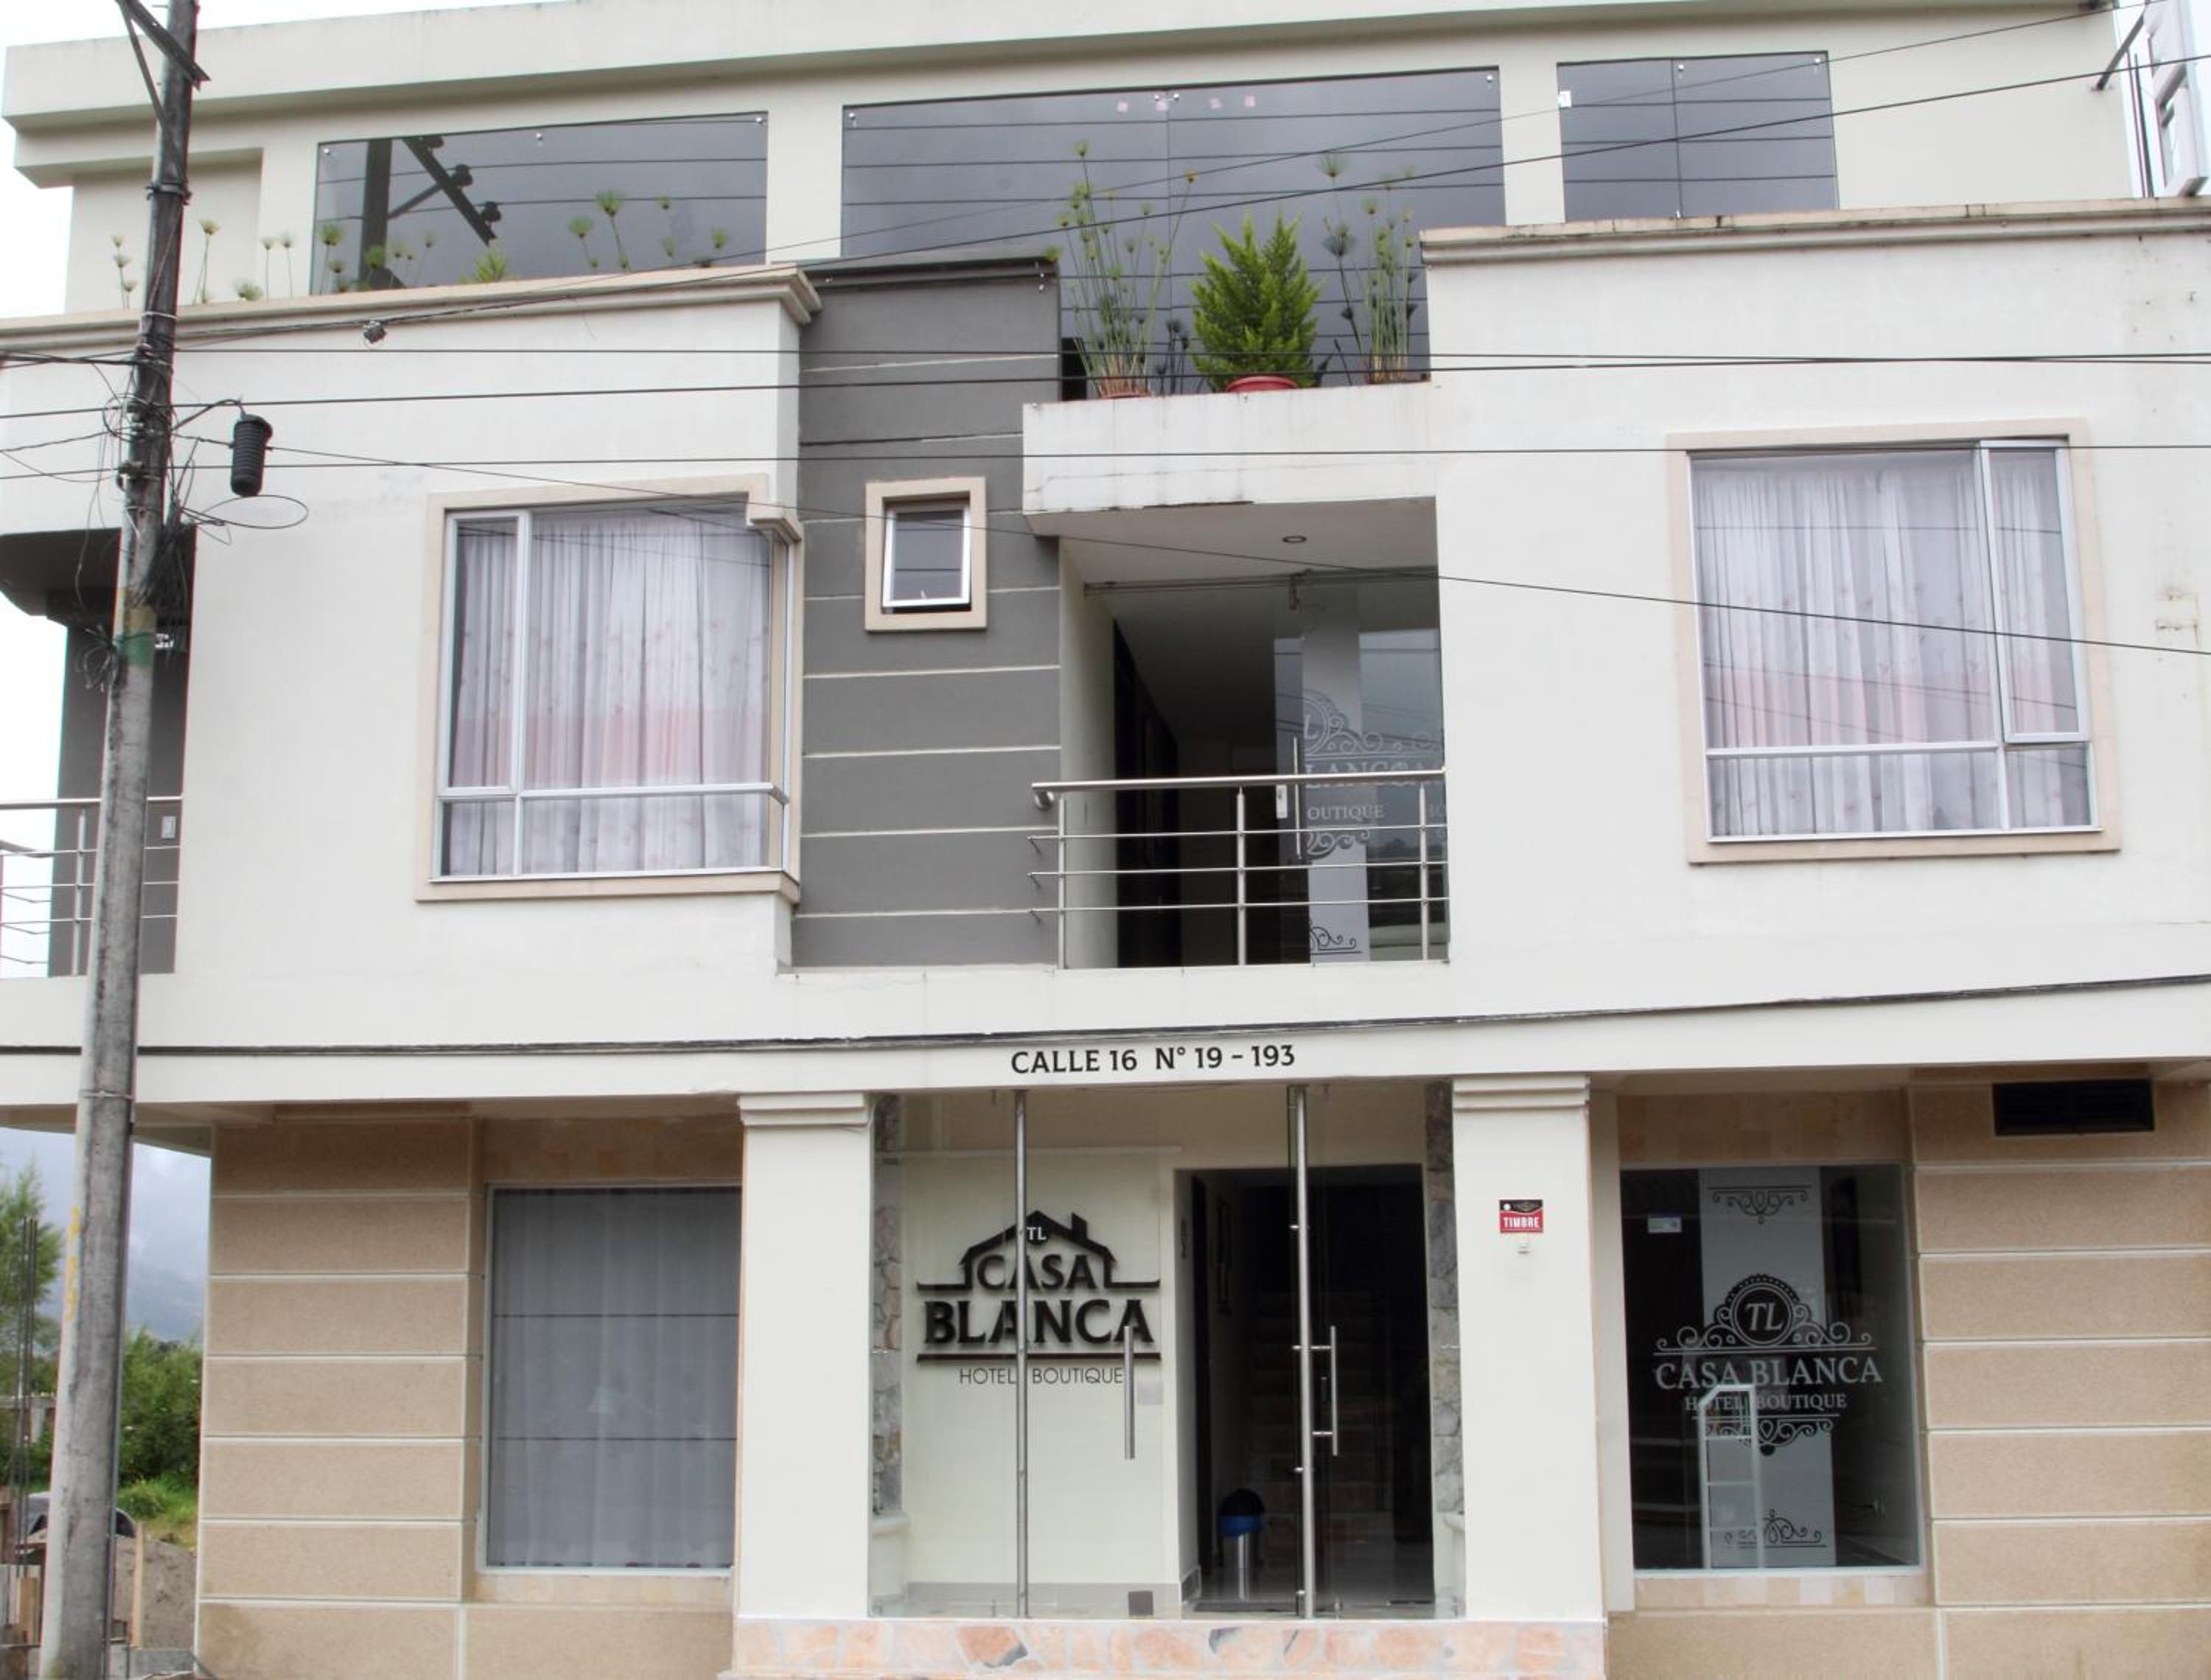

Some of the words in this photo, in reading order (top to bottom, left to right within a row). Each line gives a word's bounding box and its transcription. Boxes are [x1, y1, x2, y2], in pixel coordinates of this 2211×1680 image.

[1011, 1049, 1100, 1074] CALLE
[1110, 1049, 1138, 1071] 16
[1195, 1046, 1223, 1068] 19
[1251, 1044, 1295, 1067] 193
[1027, 1226, 1047, 1240] TL
[1503, 1217, 1540, 1228] TIMBRE
[977, 1253, 1098, 1290] CASA
[924, 1299, 1154, 1343] BLANCA
[1745, 1302, 1784, 1331] TL
[960, 1368, 1016, 1385] HOTEL
[1033, 1367, 1124, 1385] BOUTIQUE
[1655, 1361, 1740, 1389] CASA
[1750, 1356, 1882, 1386] BLANCA
[1756, 1393, 1848, 1411] BOUTIQUE
